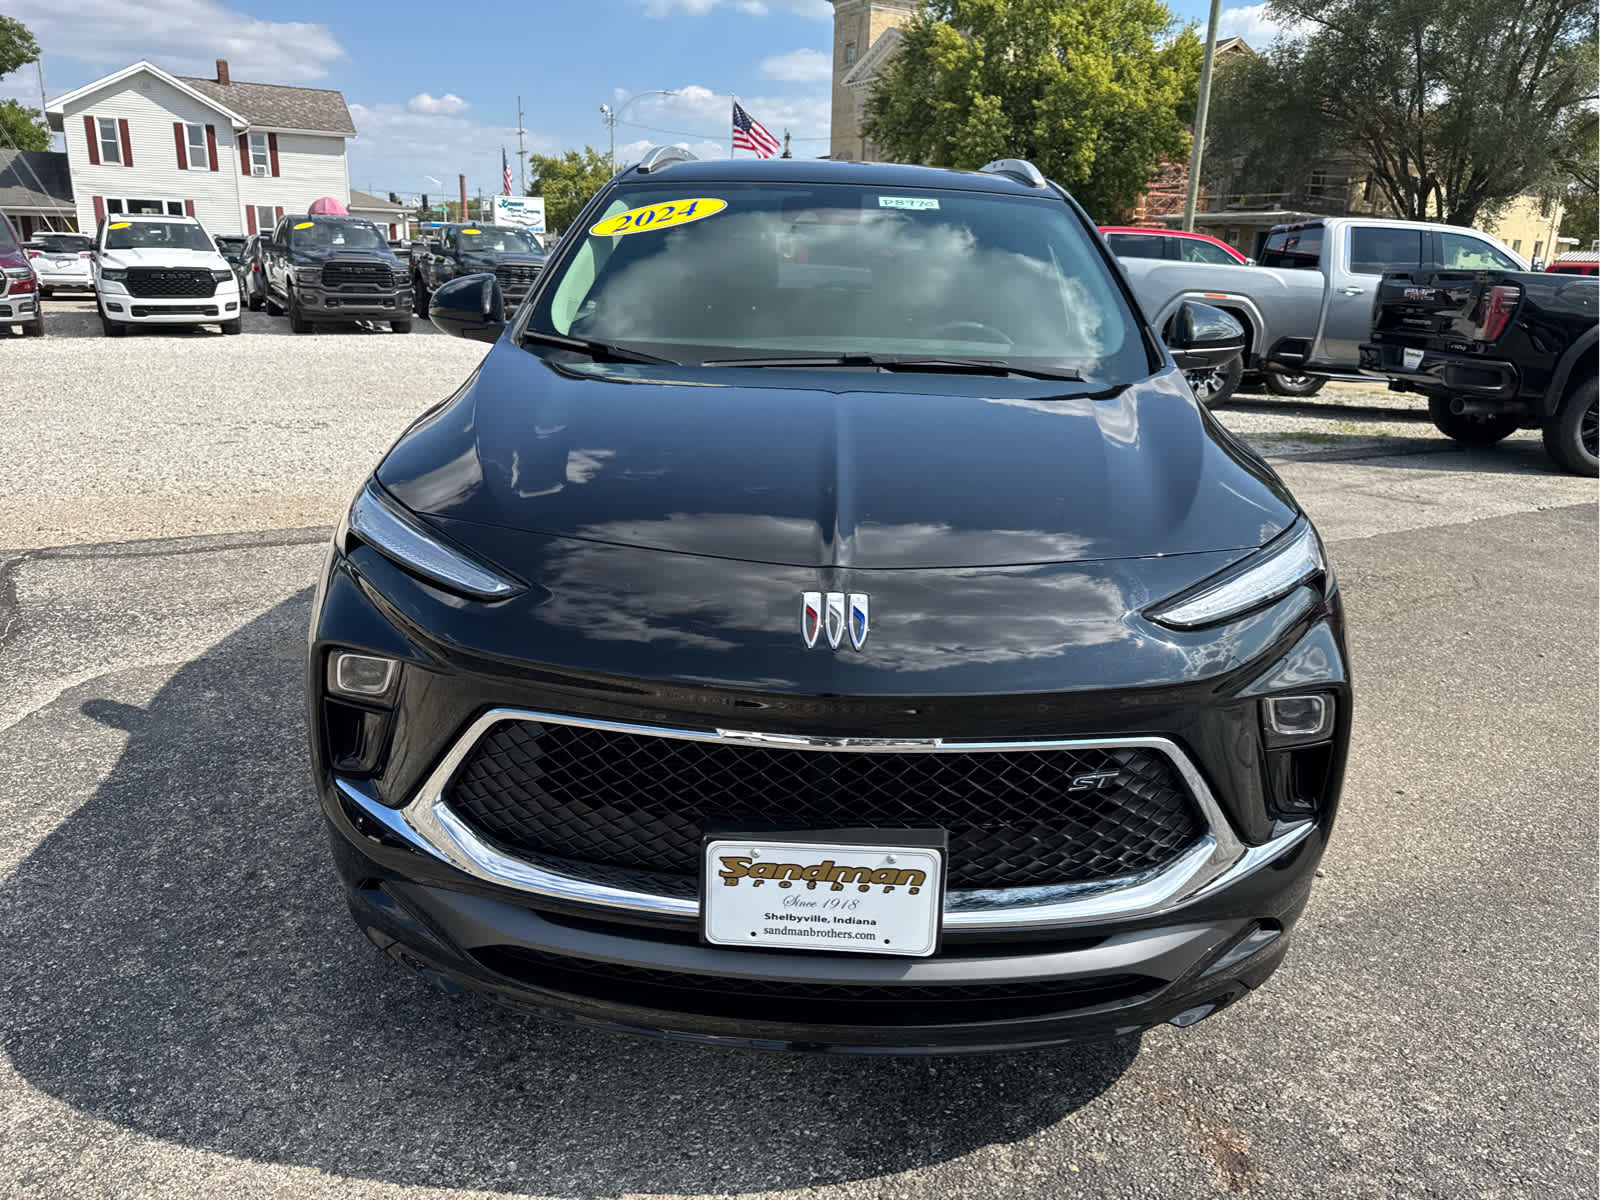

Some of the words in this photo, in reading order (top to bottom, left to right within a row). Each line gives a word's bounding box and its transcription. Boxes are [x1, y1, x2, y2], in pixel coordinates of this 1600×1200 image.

[613, 201, 698, 232] 2024
[1068, 769, 1120, 792] ST
[718, 856, 926, 887] Sandman
[723, 876, 920, 895] Brothers
[782, 895, 818, 909] Since
[821, 898, 860, 910] 1918
[764, 912, 831, 924] Shelbyville,
[833, 917, 877, 926] Indiana
[763, 927, 876, 941] sandmanbrothers.com
